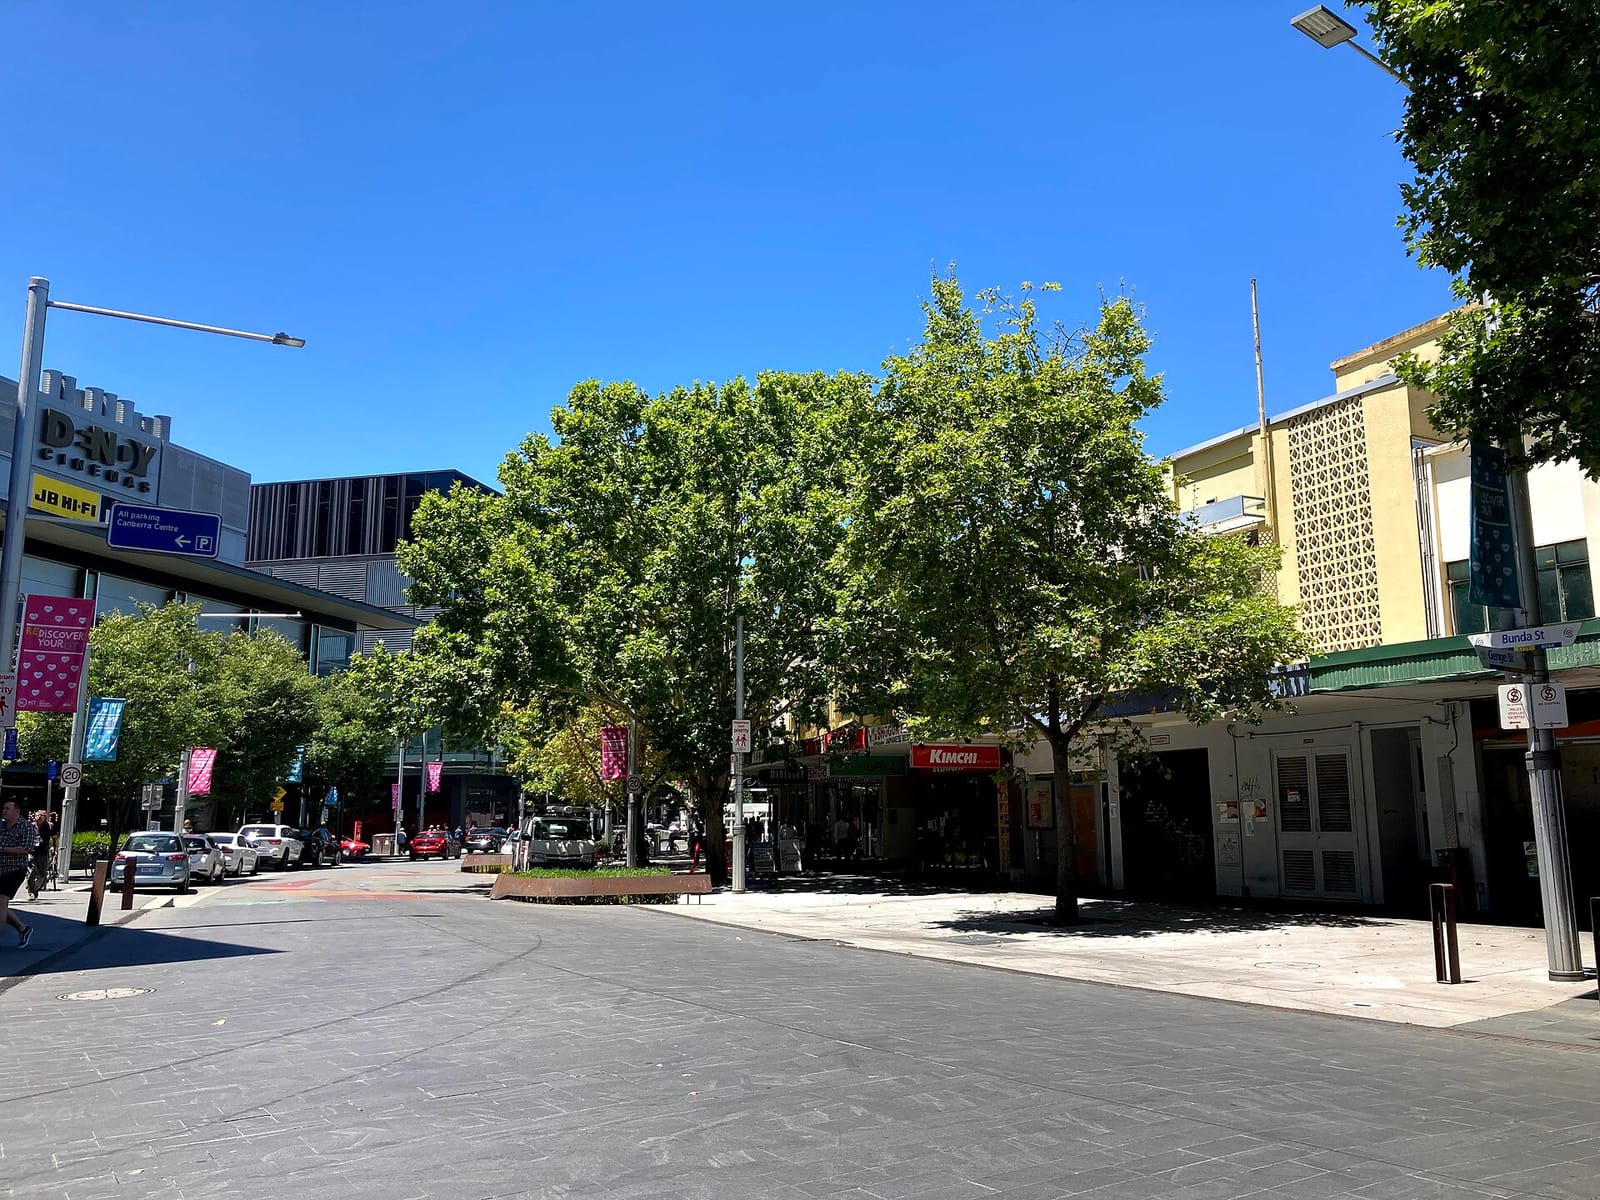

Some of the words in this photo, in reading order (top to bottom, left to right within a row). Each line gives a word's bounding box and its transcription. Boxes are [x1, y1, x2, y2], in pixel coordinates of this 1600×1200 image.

[40, 447, 151, 493] CINEMAS
[34, 489, 59, 506] JB
[118, 510, 129, 518] All
[130, 512, 161, 522] parking
[117, 518, 152, 530] Canberra
[153, 522, 179, 533] Centre
[199, 538, 209, 549] P
[1502, 632, 1533, 644] Bunda
[1534, 630, 1545, 641] St
[38, 638, 64, 649] YOUR
[1507, 653, 1514, 664] St
[65, 771, 79, 780] 20
[629, 780, 639, 788] 20
